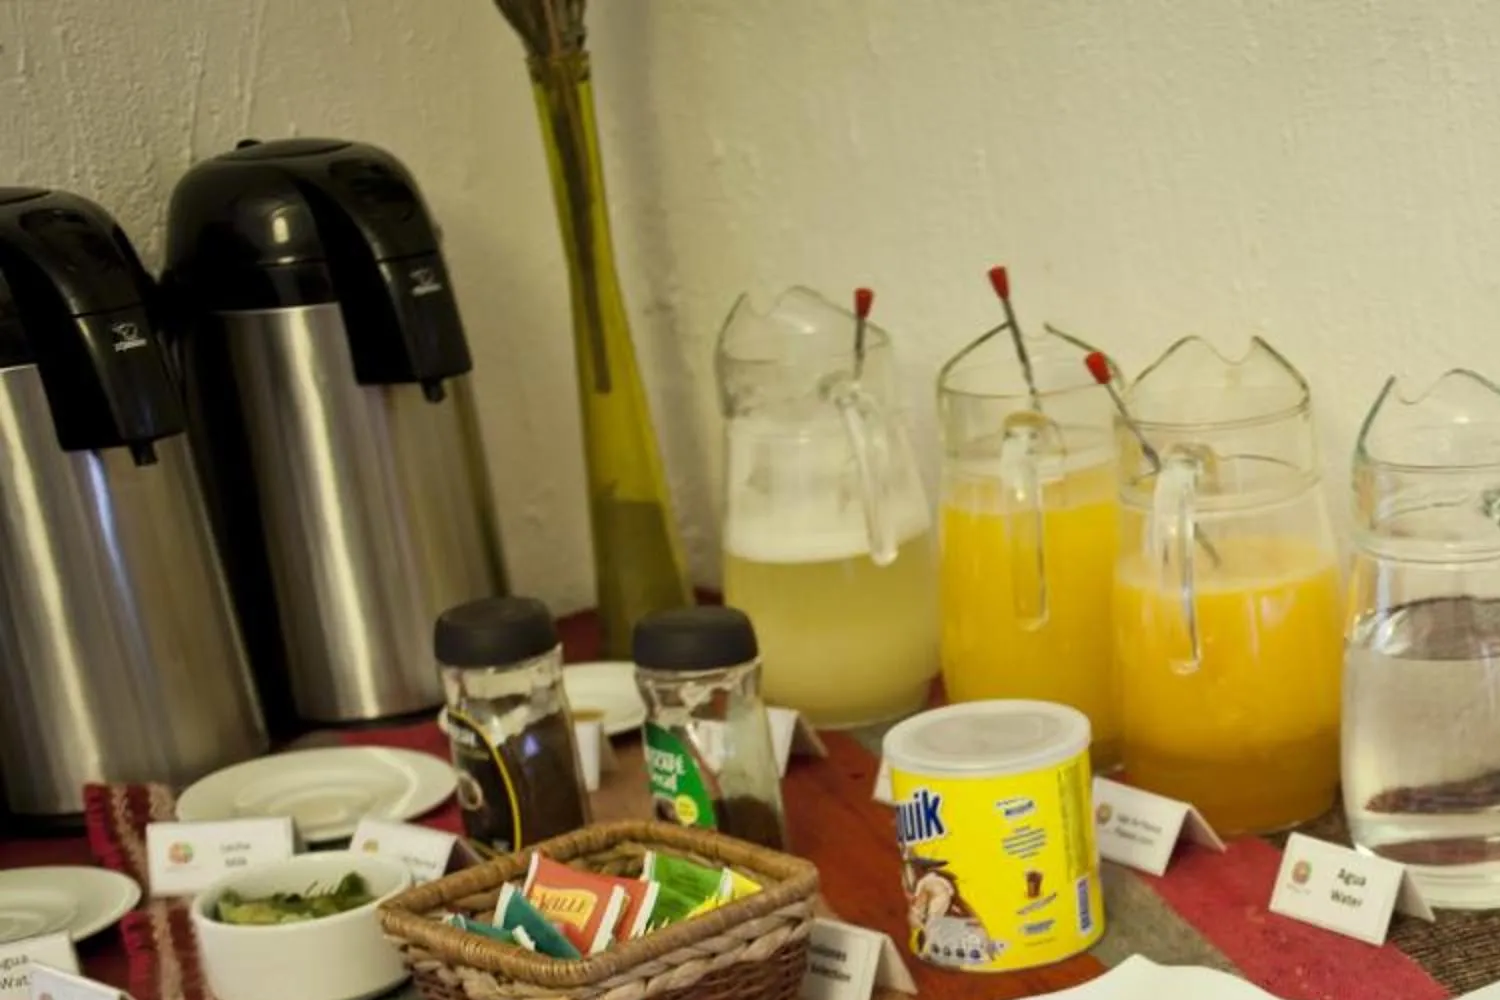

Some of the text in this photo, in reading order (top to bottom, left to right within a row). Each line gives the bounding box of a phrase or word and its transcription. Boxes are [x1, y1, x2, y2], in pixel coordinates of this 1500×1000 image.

[1337, 867, 1367, 887] Agua
[1330, 890, 1363, 908] Water
[0, 954, 29, 971] gua
